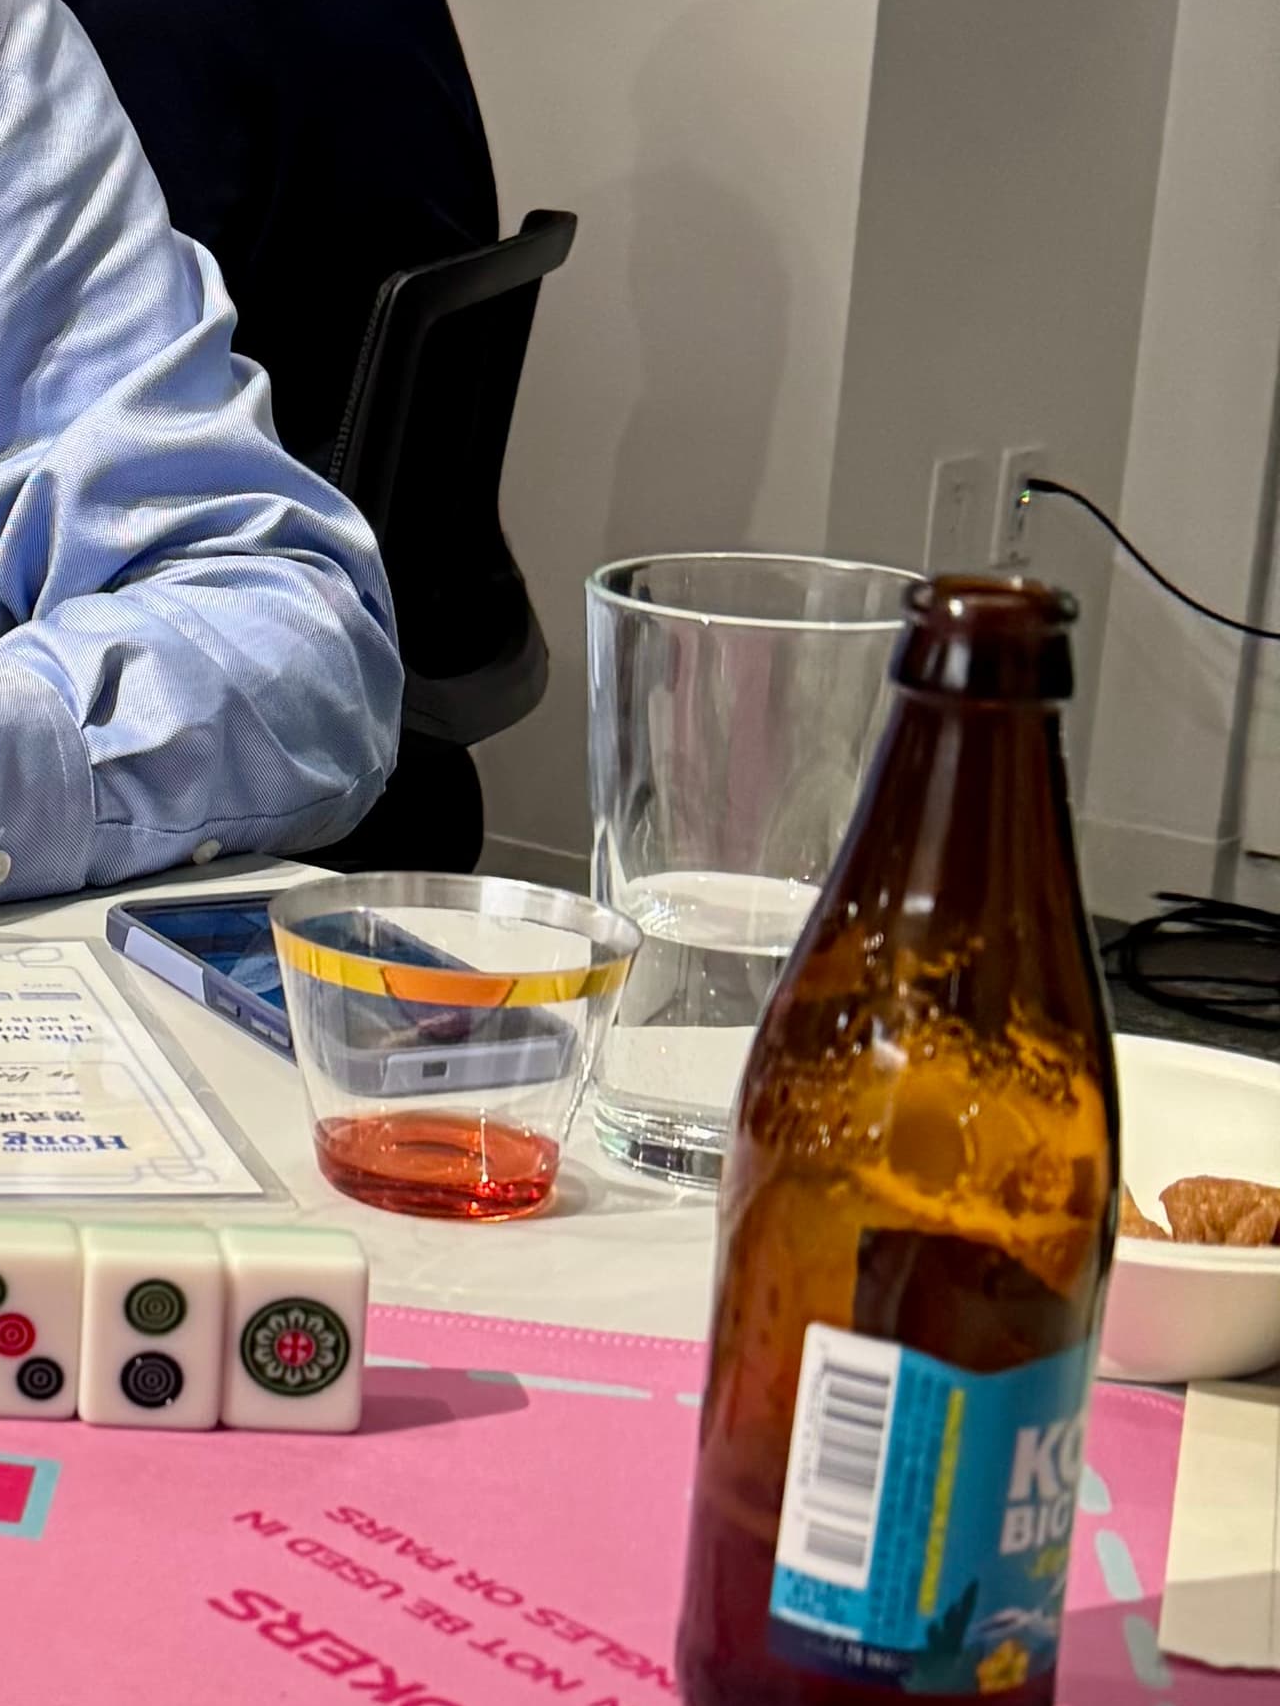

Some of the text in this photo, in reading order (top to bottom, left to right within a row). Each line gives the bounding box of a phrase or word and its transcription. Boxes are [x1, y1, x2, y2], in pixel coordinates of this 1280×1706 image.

[39, 1034, 89, 1043] The
[2, 1131, 130, 1150] Hong
[232, 1509, 289, 1541] IN
[324, 1505, 457, 1572] PAIRS
[285, 1536, 405, 1603] USED
[453, 1570, 524, 1608] OR
[402, 1597, 474, 1636] BE
[470, 1637, 585, 1693] NOT
